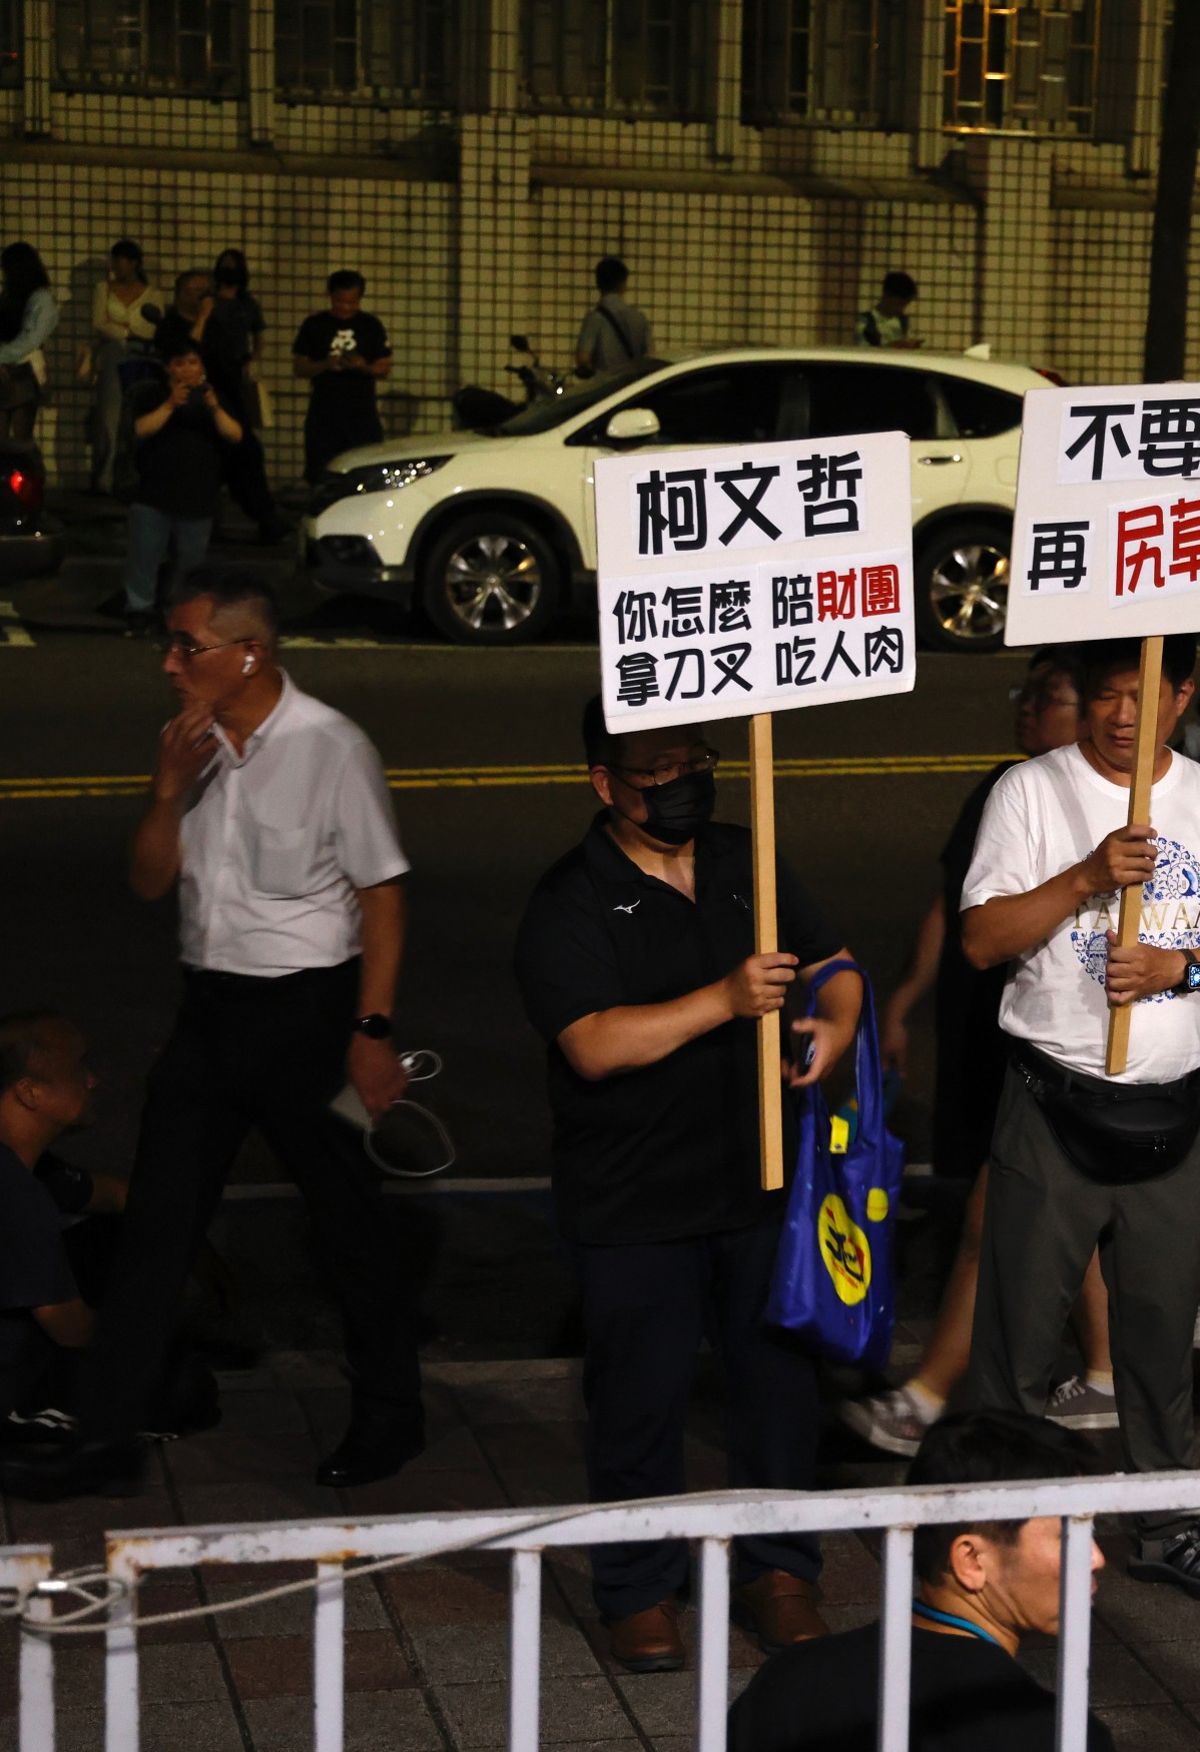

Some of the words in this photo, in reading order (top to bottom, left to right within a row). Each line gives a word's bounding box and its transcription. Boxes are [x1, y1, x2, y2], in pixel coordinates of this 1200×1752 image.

[636, 451, 863, 556] 柯文哲
[1027, 520, 1091, 592] 再
[612, 579, 752, 645] 你怎麼
[615, 641, 754, 707] 拿刀叉
[774, 625, 904, 687] 吃人肉
